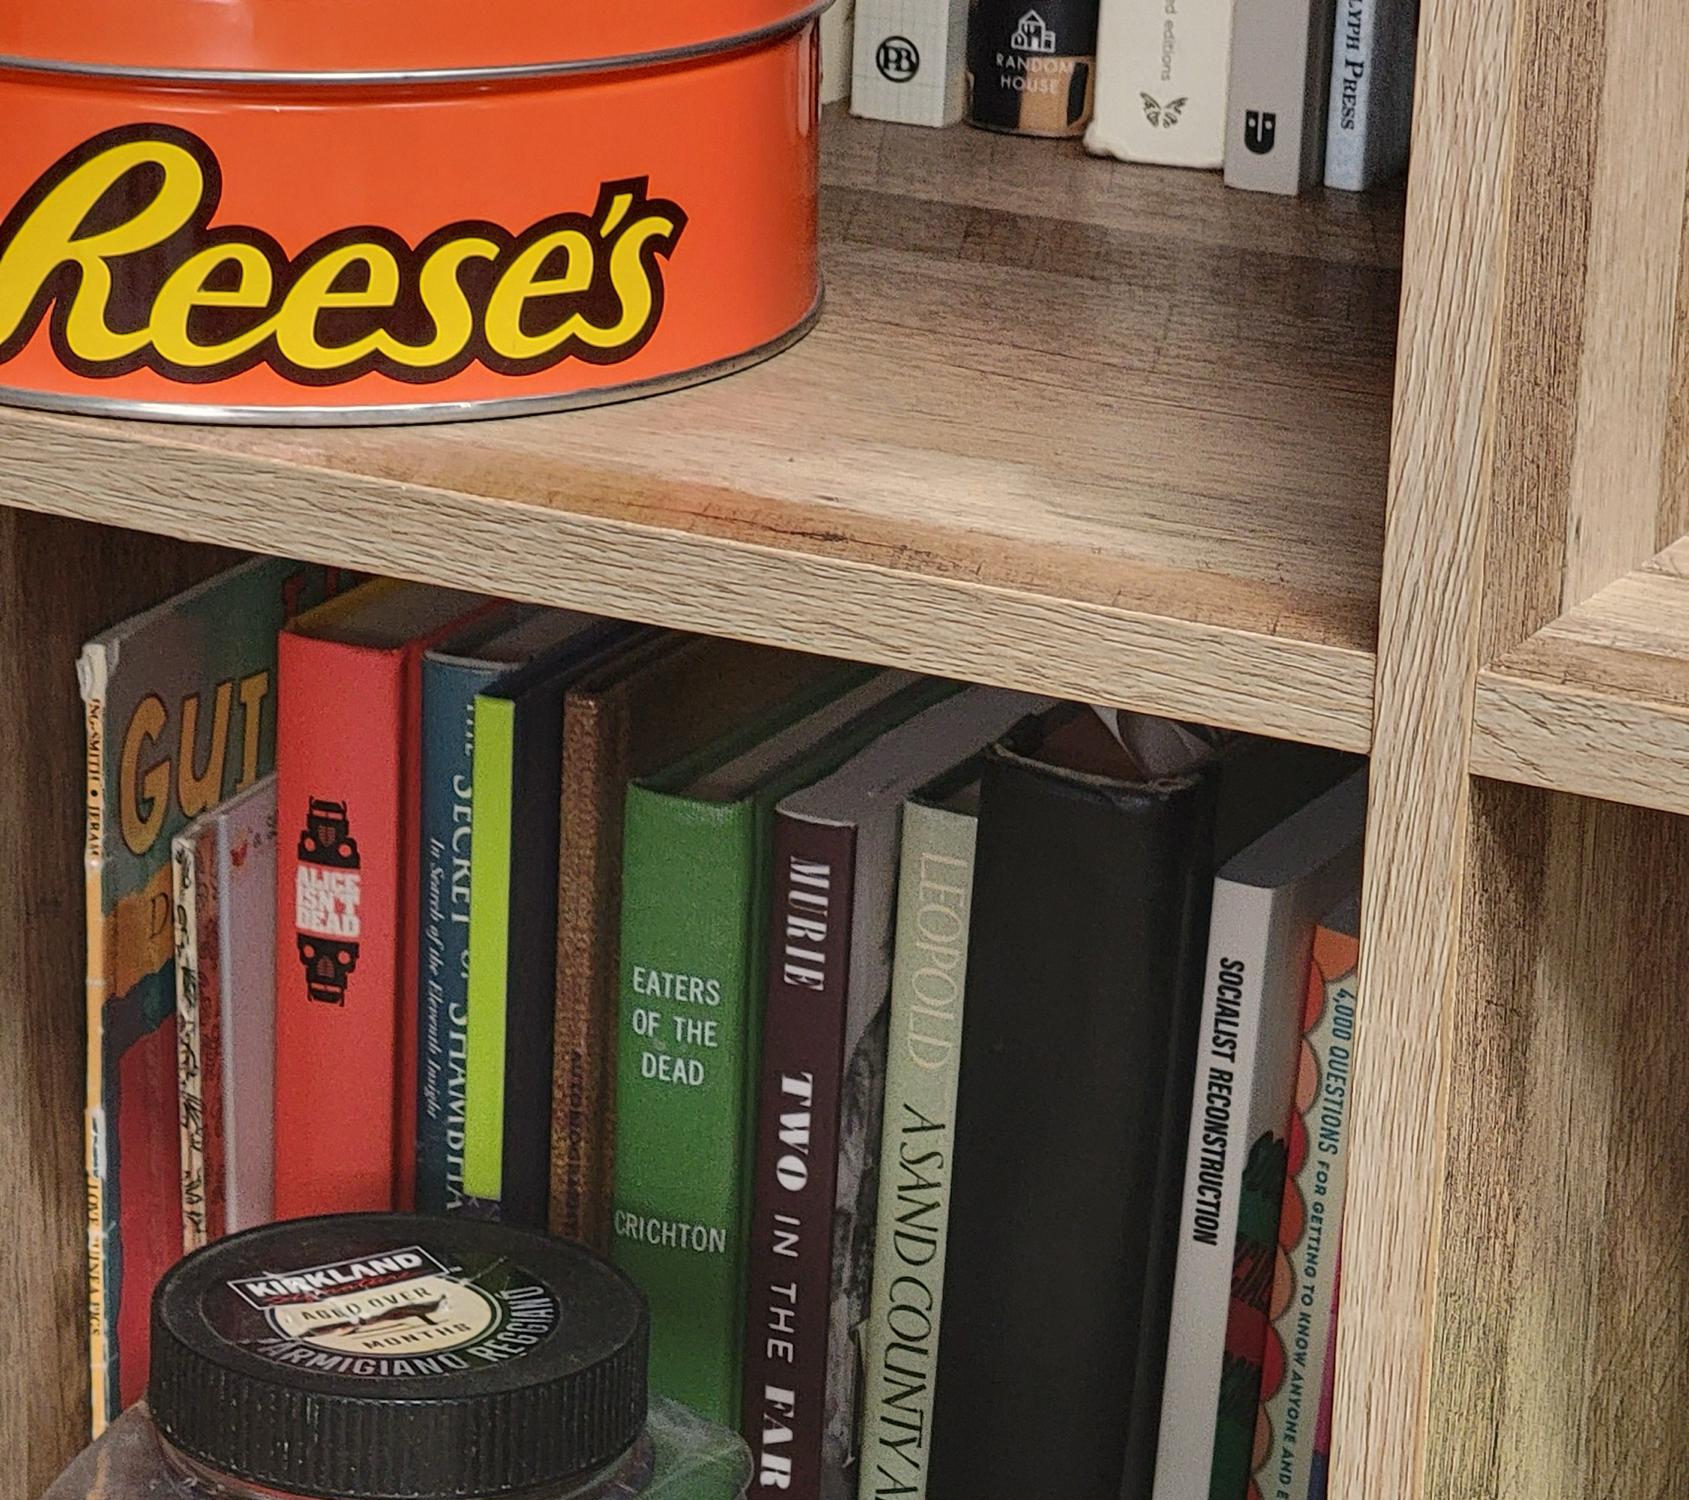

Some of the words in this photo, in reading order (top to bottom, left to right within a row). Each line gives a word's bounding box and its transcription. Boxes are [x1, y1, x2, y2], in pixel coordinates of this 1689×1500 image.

[996, 53, 1075, 75] RANDOM
[1160, 19, 1176, 82] editions
[1000, 77, 1059, 94] HOUSE
[0, 130, 682, 378] Reese's
[430, 838, 446, 858] In
[296, 886, 360, 916] ISN'T
[297, 865, 360, 896] ALICE
[429, 862, 446, 922] Search
[295, 905, 360, 937] DEAD
[425, 925, 445, 951] of
[783, 855, 831, 991] MURIE
[907, 852, 969, 1072] LEOPOLD
[632, 965, 721, 1007] EATERS
[632, 1009, 661, 1038] OF
[673, 1015, 718, 1048] THE
[1212, 957, 1245, 1064] SOCIALIST
[1332, 987, 1355, 1041] 4,000
[641, 1052, 704, 1086] DEAD
[902, 1103, 946, 1134] A
[1318, 1044, 1350, 1156] QUESTIONS
[776, 1071, 813, 1192] TWO
[1193, 1066, 1234, 1246] RECONSTRUCTION
[1314, 1160, 1330, 1197] FOR
[893, 1141, 945, 1266] SAND
[614, 1209, 727, 1254] CRICHTON
[772, 1213, 801, 1257] IN
[1304, 1201, 1325, 1279] GETTING
[246, 1253, 423, 1298] KIRKLAND
[1301, 1283, 1316, 1306] TO
[368, 1286, 431, 1312] OVER
[362, 1323, 472, 1350] MONTHS
[473, 1285, 554, 1363] REGGIANO
[766, 1282, 797, 1364] THE
[1291, 1311, 1312, 1368] KNOW
[878, 1276, 933, 1471] COUNTY
[1283, 1371, 1304, 1444] ANYONE
[759, 1384, 796, 1490] FAR
[1278, 1445, 1294, 1487] AND
